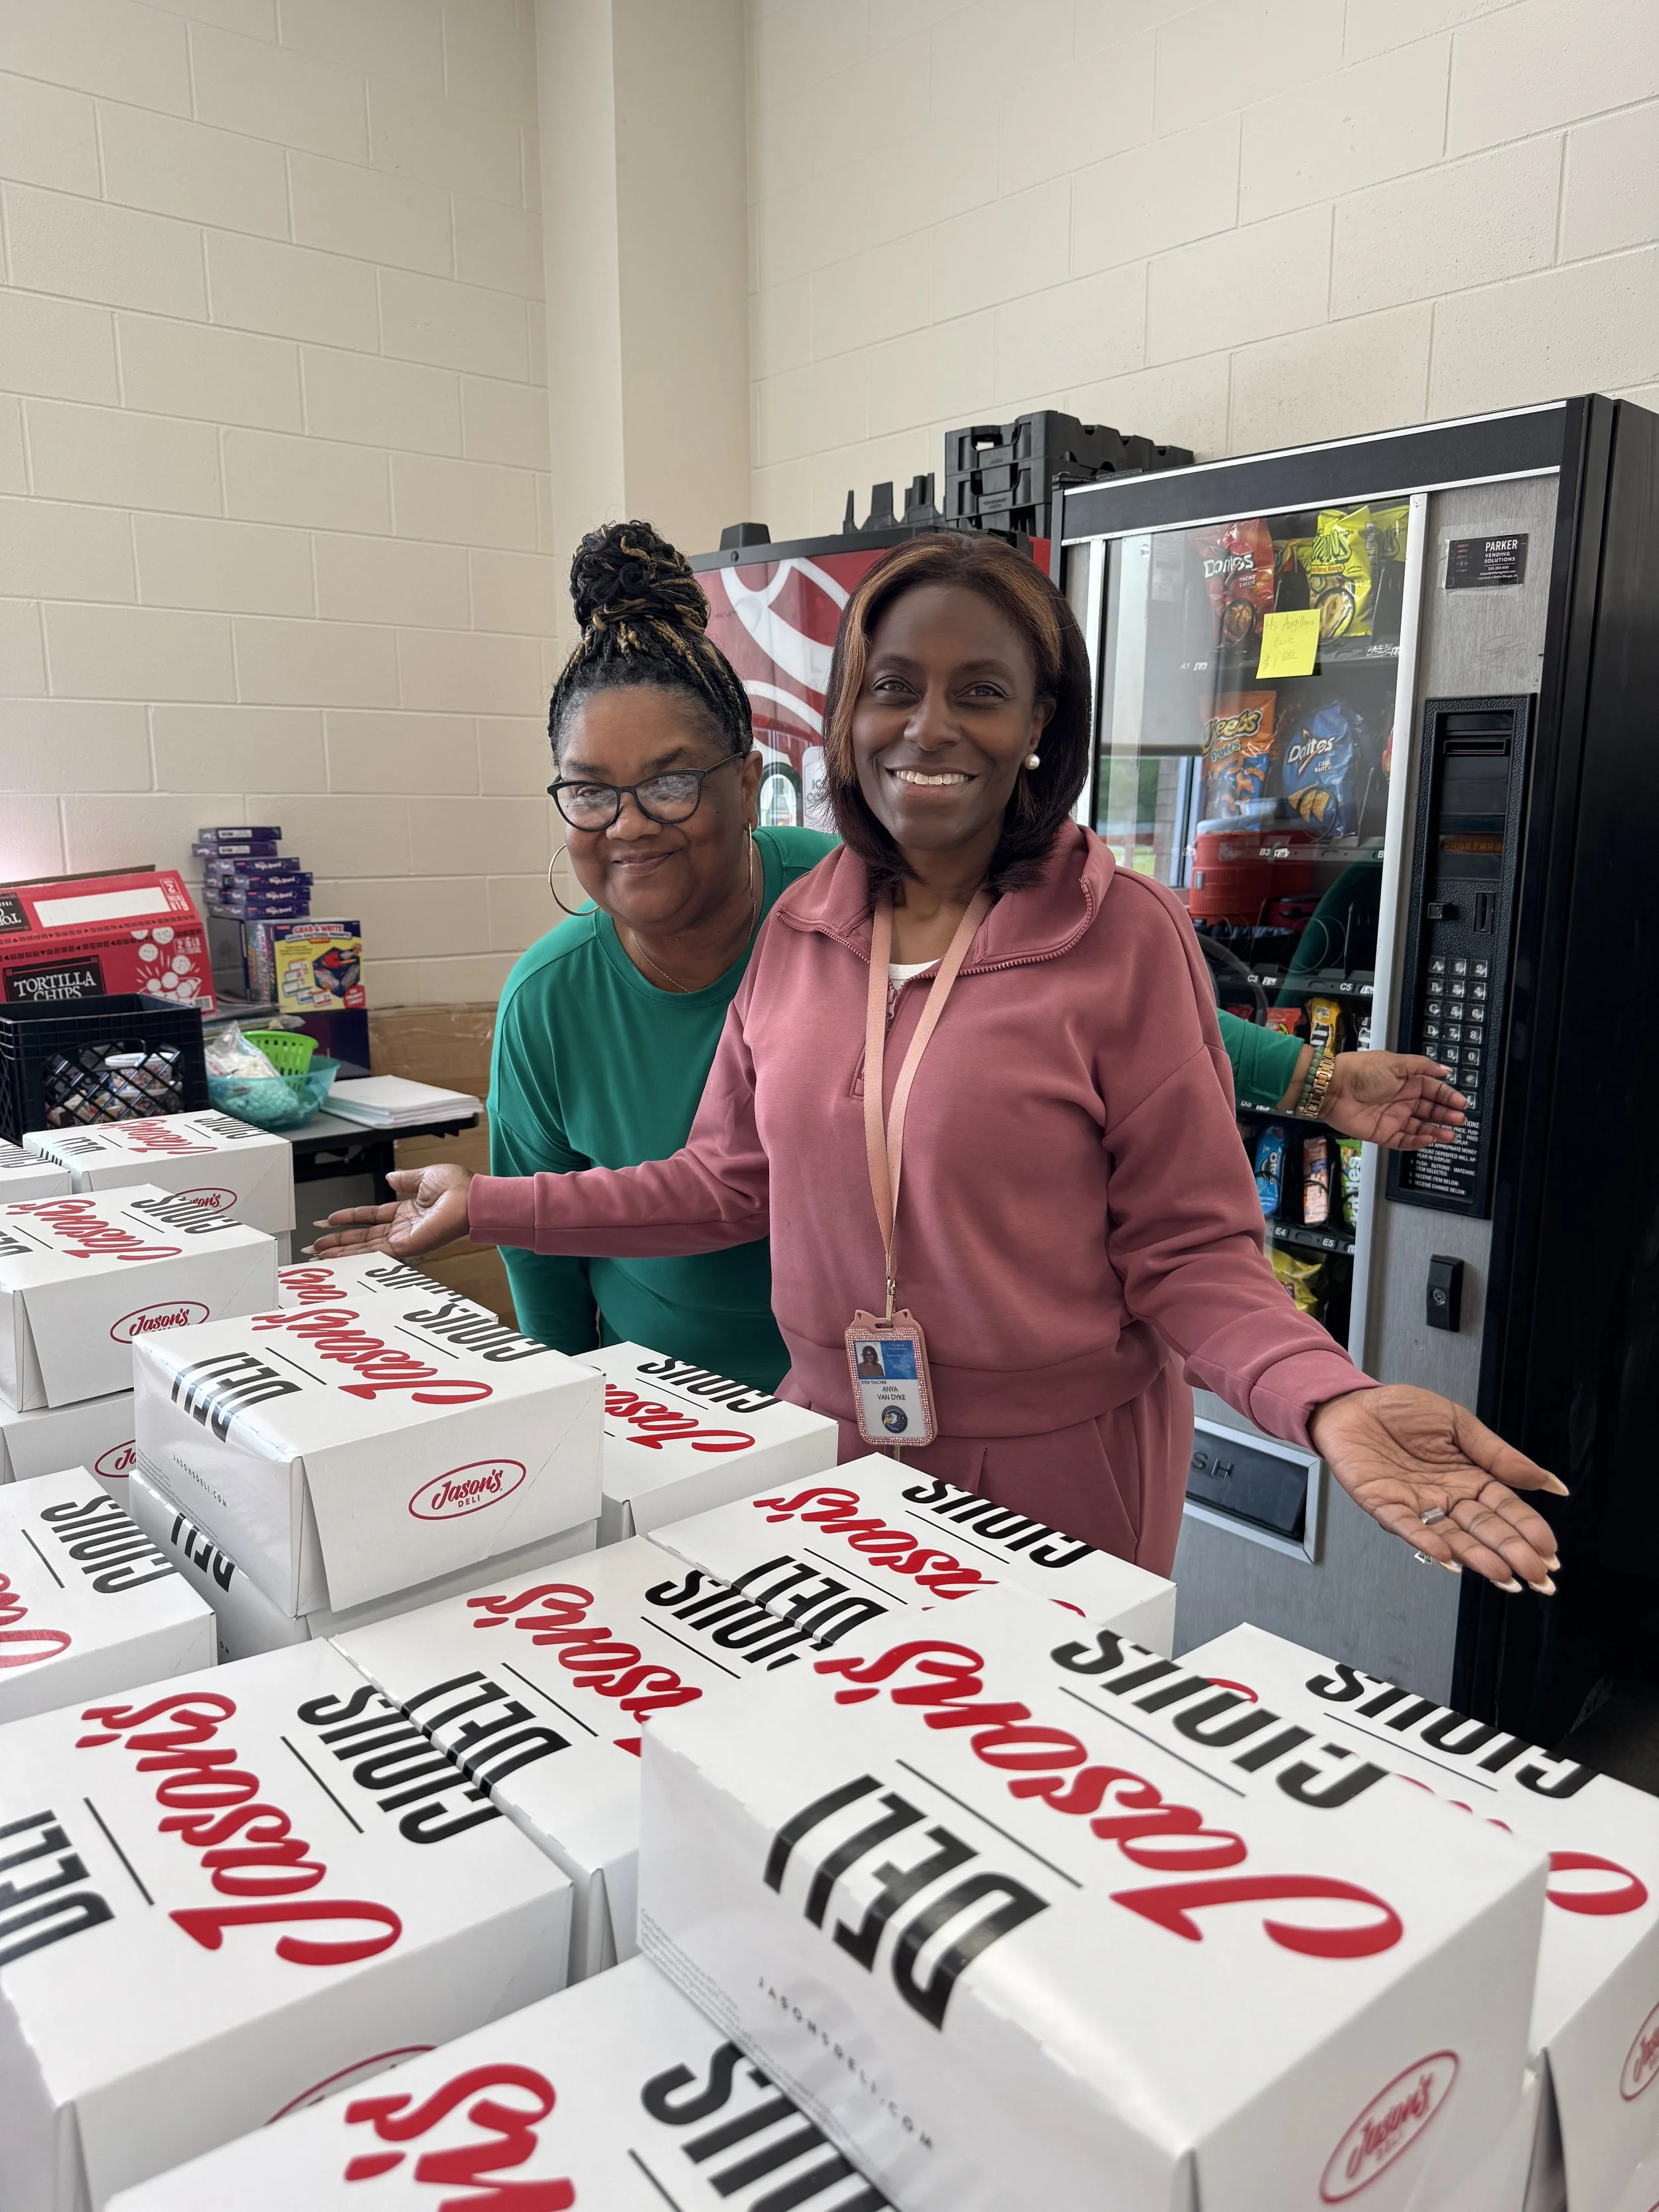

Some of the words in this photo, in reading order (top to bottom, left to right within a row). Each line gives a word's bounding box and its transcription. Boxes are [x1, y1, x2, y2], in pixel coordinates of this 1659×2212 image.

[1485, 539, 1518, 552] PARKER
[1203, 555, 1254, 578] Doritos
[1239, 579, 1256, 588] CHEESE
[1287, 735, 1336, 763] Doritos
[1259, 848, 1270, 856] B3
[14, 970, 98, 997] TORTILLA
[1247, 974, 1258, 983] C3
[1339, 983, 1352, 992] C5
[34, 985, 82, 1001] CHIPS
[1435, 1150, 1457, 1159] DEPOSITED
[6, 1199, 182, 1260] Jason's
[1273, 1227, 1286, 1236] E4
[1322, 1238, 1335, 1247] E5
[129, 1308, 190, 1336] Jason's
[252, 1308, 493, 1405] Jason's
[171, 1351, 303, 1443] DELI
[173, 1454, 227, 1509] JASONSDELI.COM
[431, 1469, 504, 1511] Jason's
[457, 1495, 480, 1508] DELI
[729, 1556, 890, 1651] DELI
[399, 1671, 572, 1797] DELI
[813, 1640, 1404, 1959] Jason's
[75, 1692, 402, 1966] Jason's
[762, 1773, 1052, 2032] DELI
[758, 1975, 932, 2149] JASONSDELI.COM
[1346, 2071, 1434, 2179] Jason's
